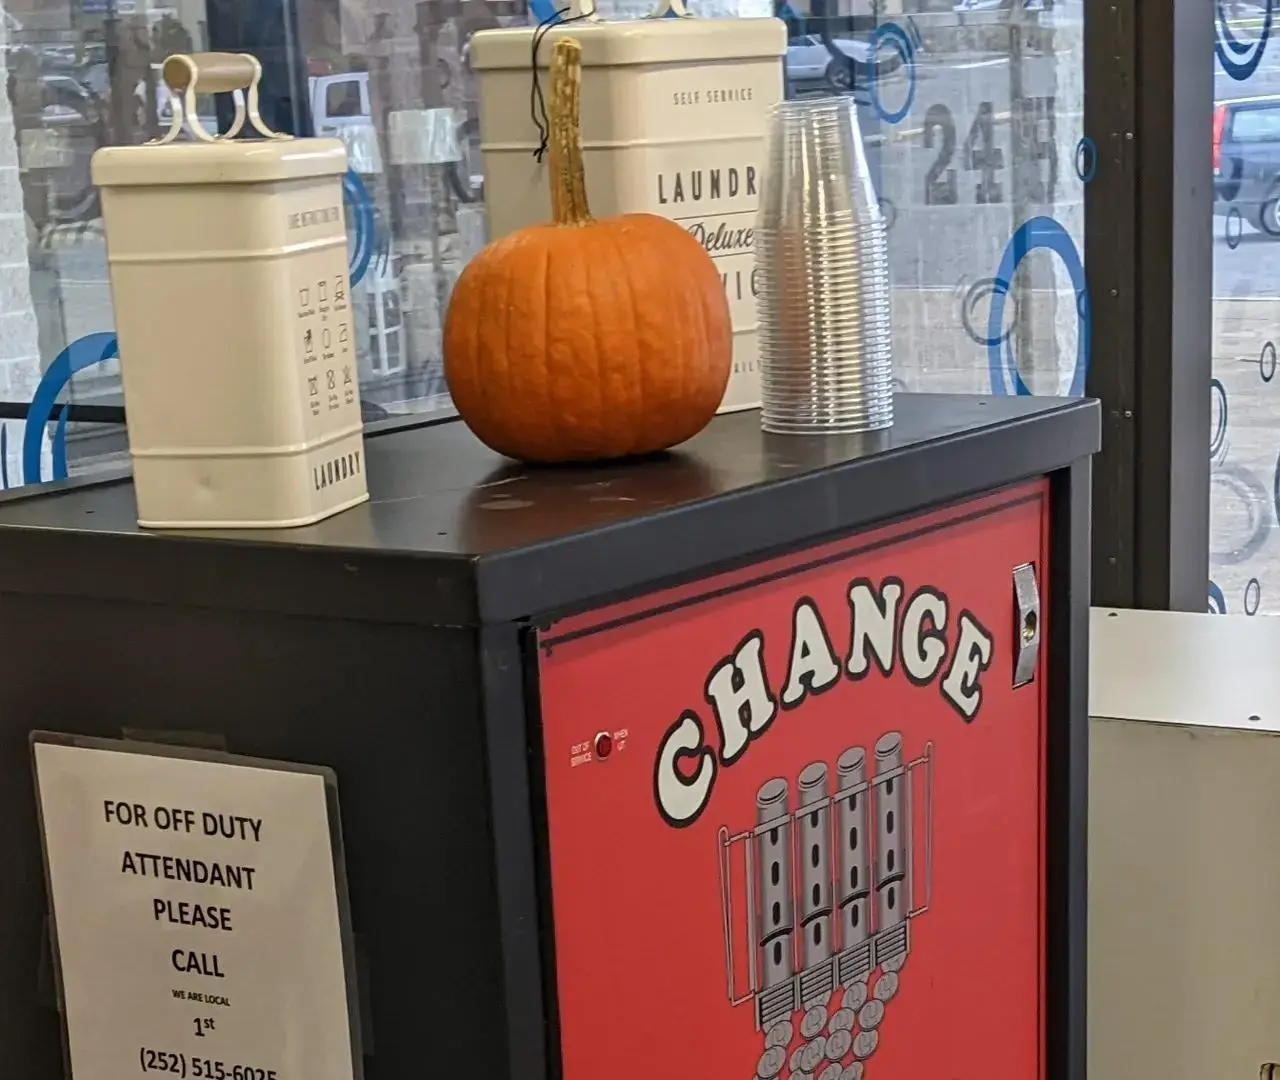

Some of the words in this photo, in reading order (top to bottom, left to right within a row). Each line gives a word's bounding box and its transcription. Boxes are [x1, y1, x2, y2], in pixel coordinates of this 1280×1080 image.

[657, 165, 757, 204] LAUNDR
[313, 451, 361, 491] LAUNDRY
[653, 577, 995, 829] CHANGE
[103, 799, 149, 829] FOR
[153, 806, 197, 835] OFF
[201, 813, 263, 844] DUTY
[120, 850, 256, 892] ATTENDANT
[152, 897, 233, 932] PLEASE
[171, 948, 225, 979] CALL
[171, 988, 186, 1000] WE
[187, 991, 204, 1003] ARE
[204, 994, 232, 1008] LOCAL
[193, 1017, 216, 1038] 1st
[140, 1046, 187, 1079] (252)
